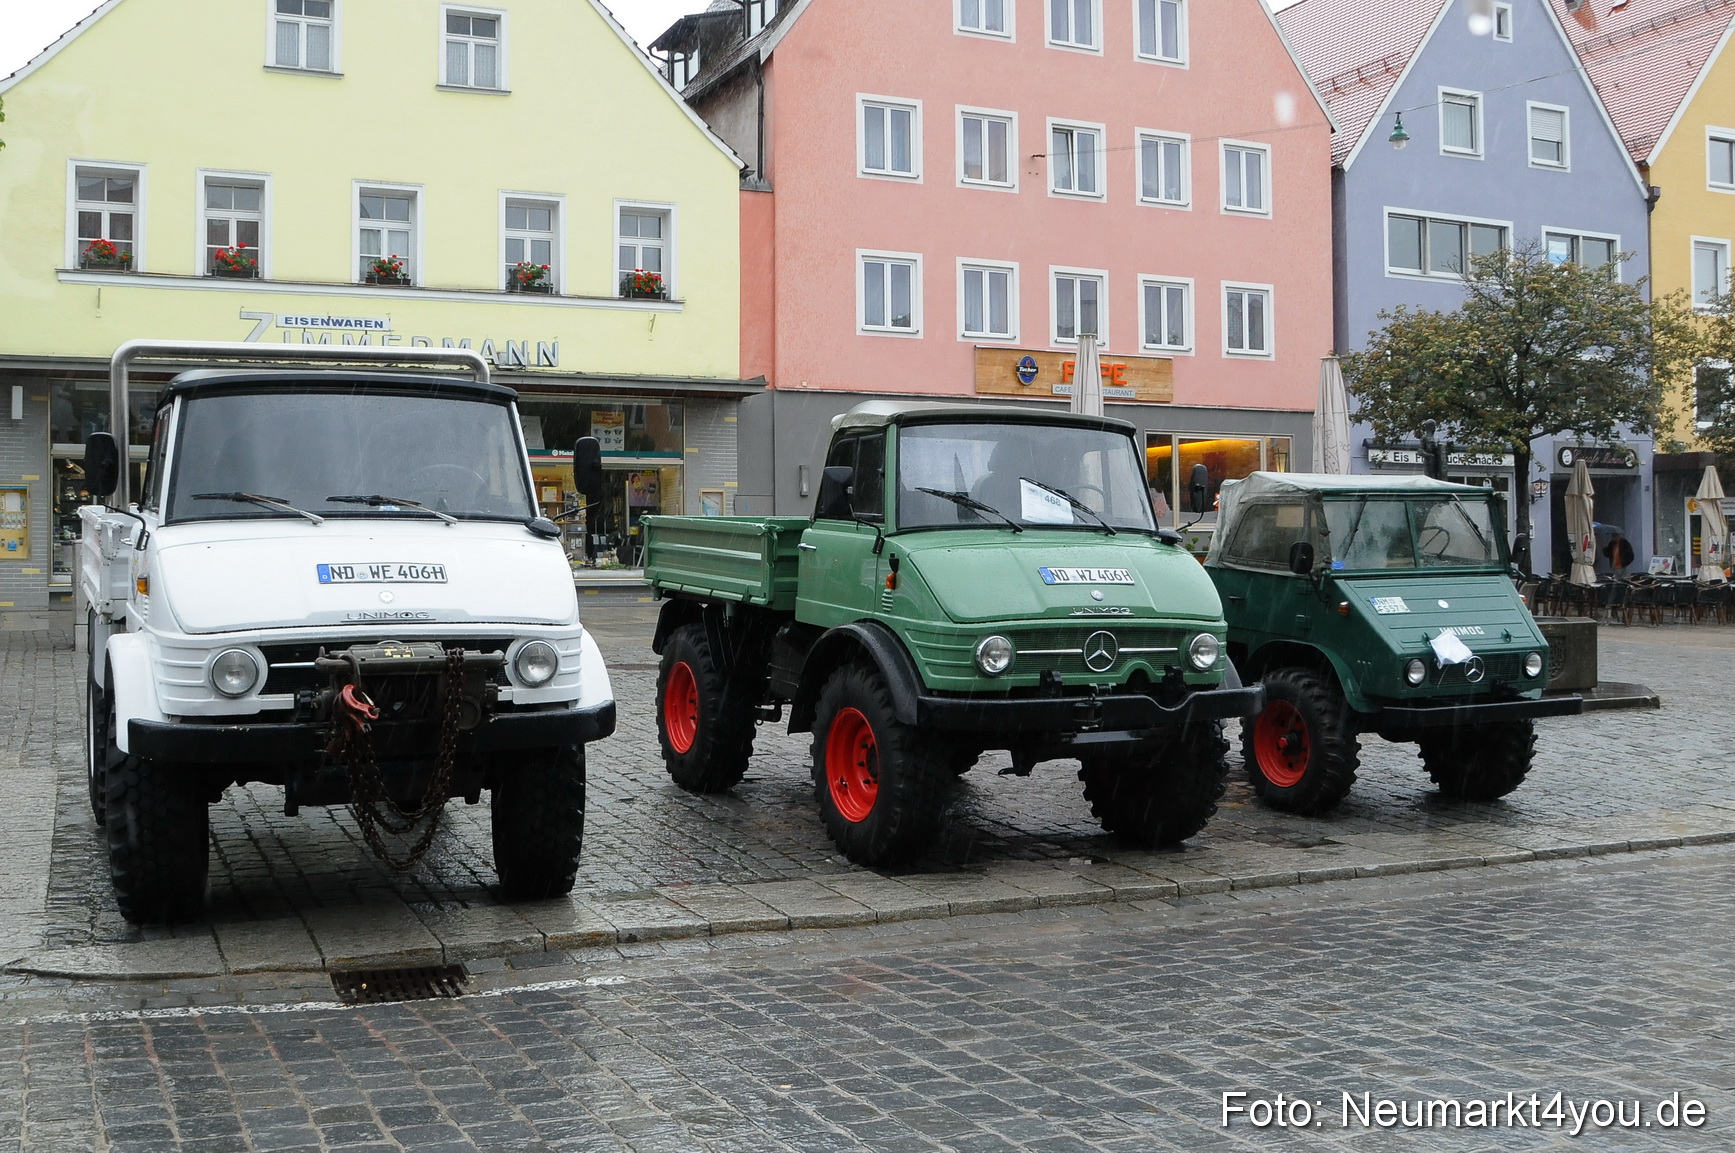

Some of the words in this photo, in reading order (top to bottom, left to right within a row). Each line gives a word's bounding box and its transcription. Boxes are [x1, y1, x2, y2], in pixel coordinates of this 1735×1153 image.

[284, 316, 384, 329] EISENWAREN
[1063, 361, 1128, 385] PPE
[1393, 452, 1410, 462] Eis
[1044, 495, 1061, 507] 468
[330, 566, 355, 580] ND
[369, 565, 394, 579] WE
[398, 565, 445, 580] 406H
[1049, 569, 1070, 581] ND
[1075, 569, 1097, 581] WZ
[1098, 570, 1133, 582] 406H
[347, 611, 430, 620] UNIMOG
[1073, 607, 1130, 615] UNIMOG
